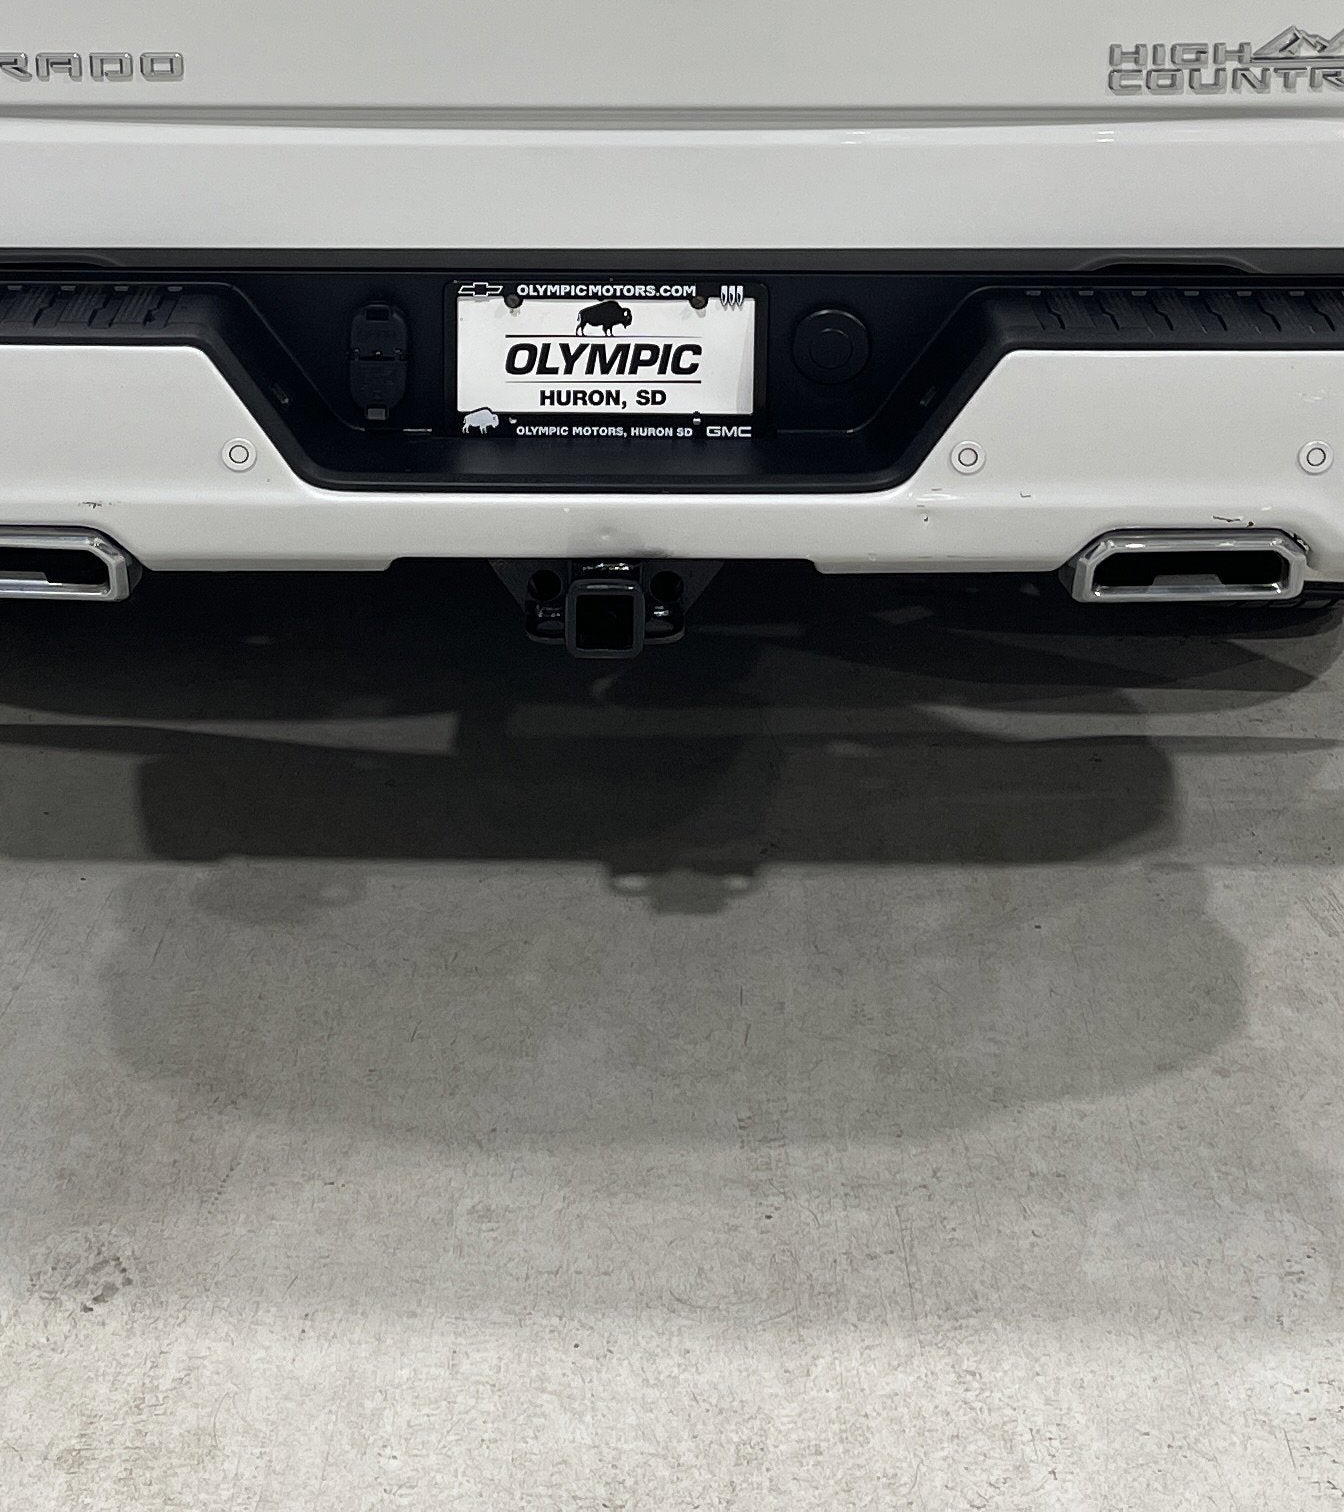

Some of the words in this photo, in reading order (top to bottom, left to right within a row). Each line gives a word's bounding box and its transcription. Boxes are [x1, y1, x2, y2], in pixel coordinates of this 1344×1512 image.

[1109, 42, 1252, 68] HIGH
[517, 284, 697, 297] OLYMPICMOTORS.COM
[505, 342, 702, 376] OLYMPIC
[539, 390, 628, 409] HURON,
[636, 390, 667, 407] SD
[516, 426, 569, 436] OLYMPIC
[572, 426, 628, 437] MOTORS,
[630, 427, 674, 437] HURON
[676, 427, 693, 437] SD
[706, 426, 752, 437] GMC
